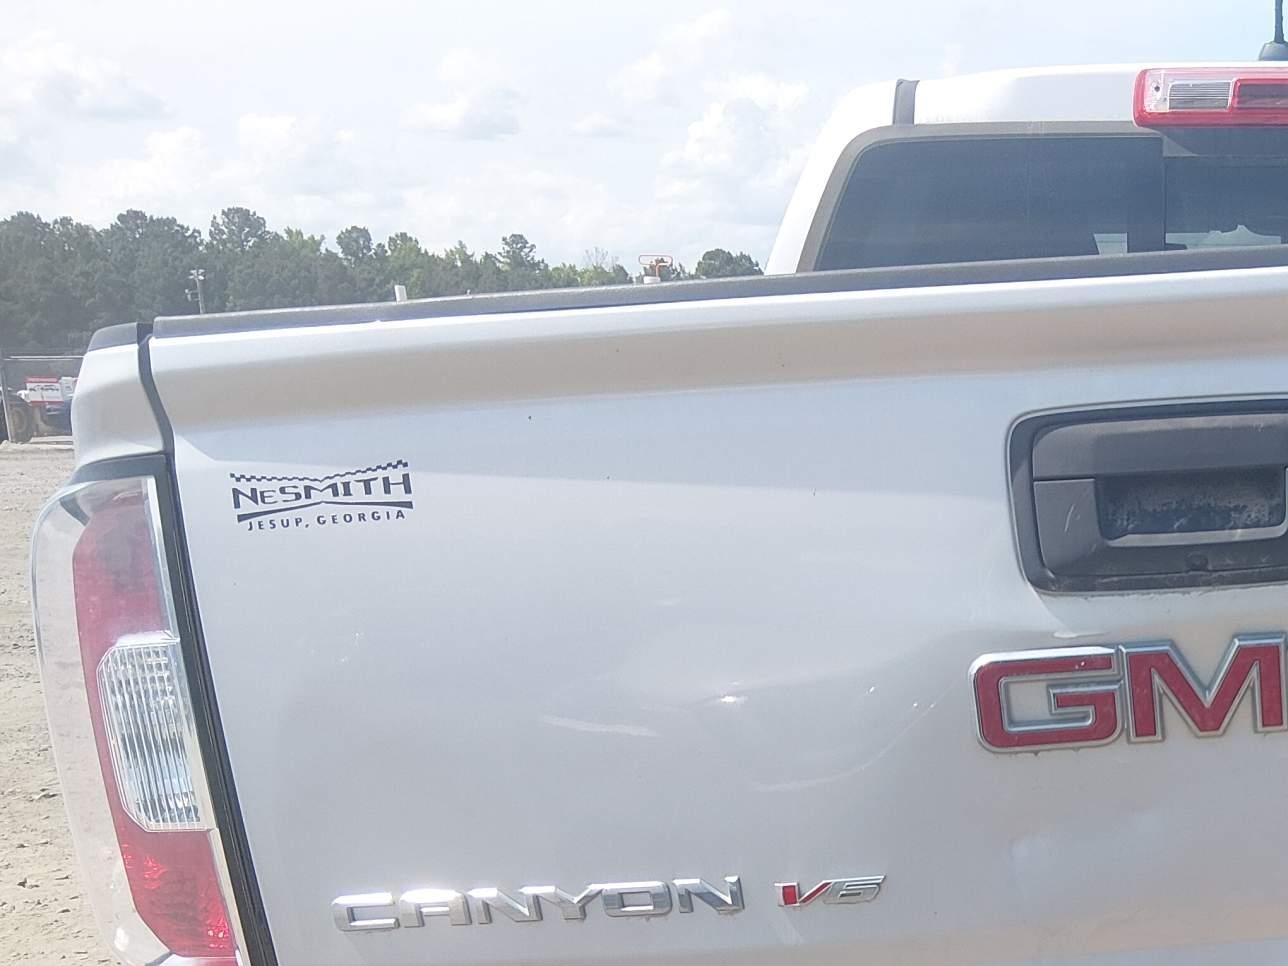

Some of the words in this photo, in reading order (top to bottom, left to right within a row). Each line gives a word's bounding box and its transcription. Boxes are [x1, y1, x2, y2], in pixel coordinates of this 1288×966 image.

[231, 473, 412, 509] NESMITH
[247, 517, 310, 531] JESUP,
[316, 510, 405, 526] GEORGIA
[331, 874, 744, 932] CANYON
[773, 873, 887, 908] V6
